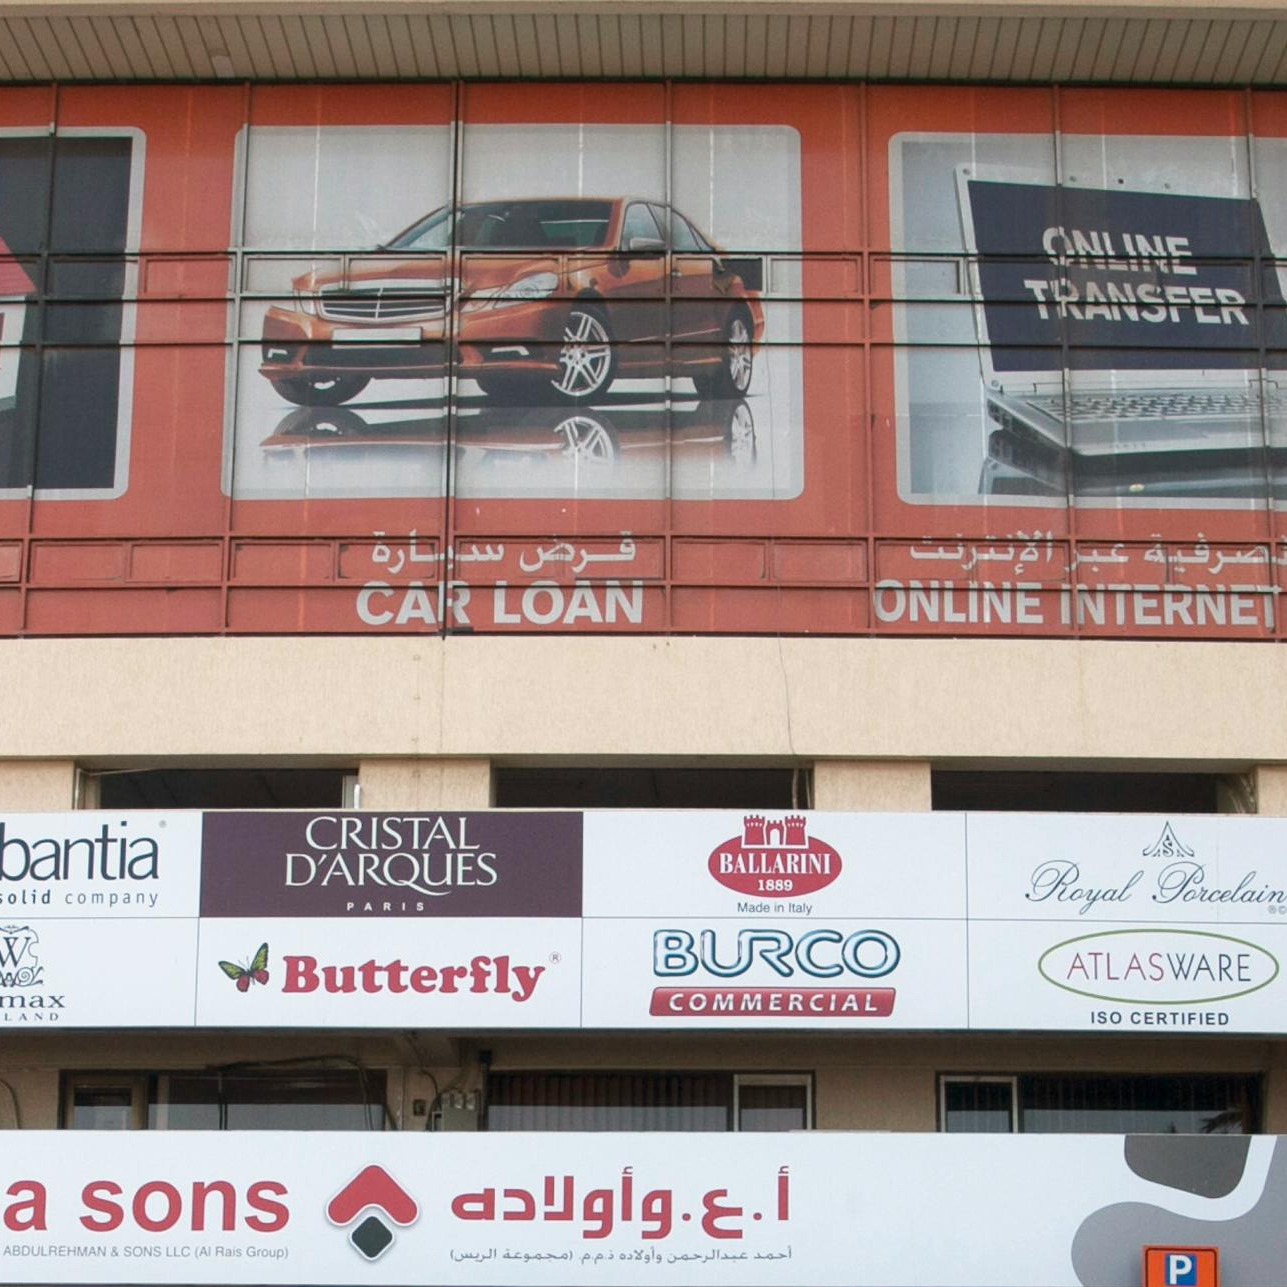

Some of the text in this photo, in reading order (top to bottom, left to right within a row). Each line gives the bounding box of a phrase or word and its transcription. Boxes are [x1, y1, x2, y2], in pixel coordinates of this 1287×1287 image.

[1042, 226, 1198, 275] ONLINE
[1024, 278, 1250, 326] TRANSFER
[371, 529, 636, 574] قرض سيارة
[1064, 543, 1130, 573] عبر
[356, 580, 644, 625] CAR LOAN
[873, 578, 1044, 625] ONLINE
[1061, 581, 1281, 629] INTERNET
[306, 816, 480, 850] CRISTAL
[285, 852, 498, 896] D'ARQUES
[719, 854, 831, 876] BALLARINI
[65, 891, 159, 907] company
[757, 879, 793, 892] 1889
[1025, 860, 1144, 915] Royal
[346, 902, 425, 912] PARIS
[737, 902, 813, 918] Made in Italy
[653, 928, 901, 979] BURCO
[1066, 952, 1252, 982] ATLASWARE
[281, 955, 546, 1002] Butterfly
[670, 993, 878, 1013] COMMERCIAL
[1091, 1011, 1229, 1026] ISO CERTIFIED
[79, 1180, 290, 1232] sons
[3, 1245, 107, 1257] ABDULREHMAN
[110, 1245, 119, 1257] &
[123, 1246, 162, 1258] SONS
[165, 1246, 190, 1258] LLC
[194, 1246, 211, 1260] (Al
[215, 1246, 243, 1258] Rais
[246, 1246, 289, 1261] Group)
[502, 1247, 573, 1263] (مجموعة
[619, 1246, 663, 1263] وأولاده
[667, 1247, 748, 1263] عبدالرحمن
[753, 1245, 792, 1260] أحمد
[1169, 1255, 1192, 1285] P
